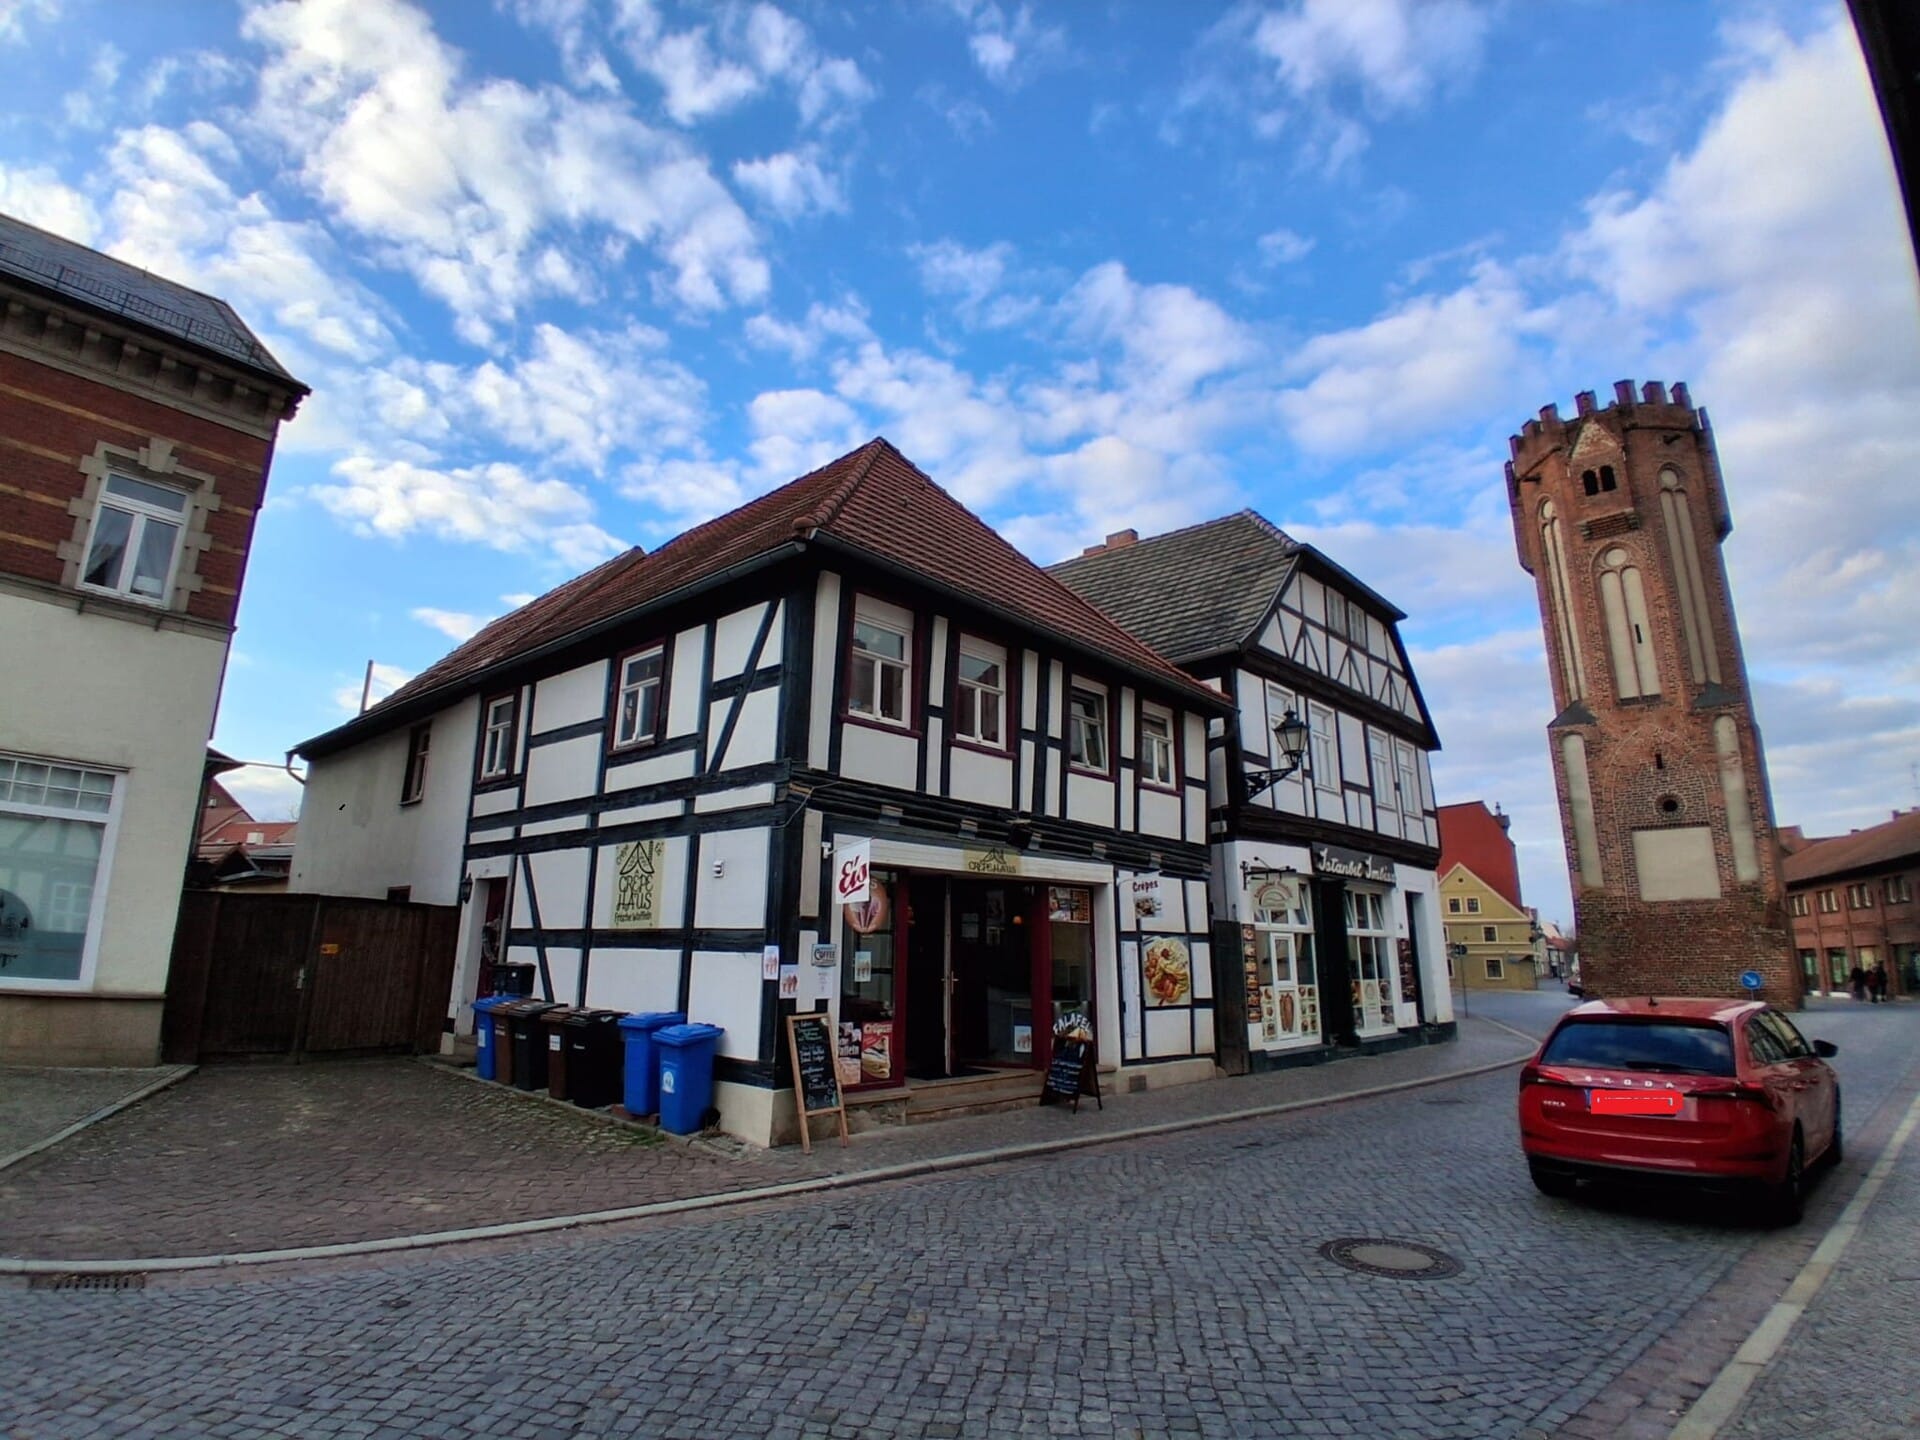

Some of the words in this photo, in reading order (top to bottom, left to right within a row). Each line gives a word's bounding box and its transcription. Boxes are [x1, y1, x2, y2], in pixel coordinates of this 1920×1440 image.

[839, 854, 867, 894] Eis
[616, 891, 653, 912] HAUS
[1053, 1012, 1090, 1035] FALAFEL
